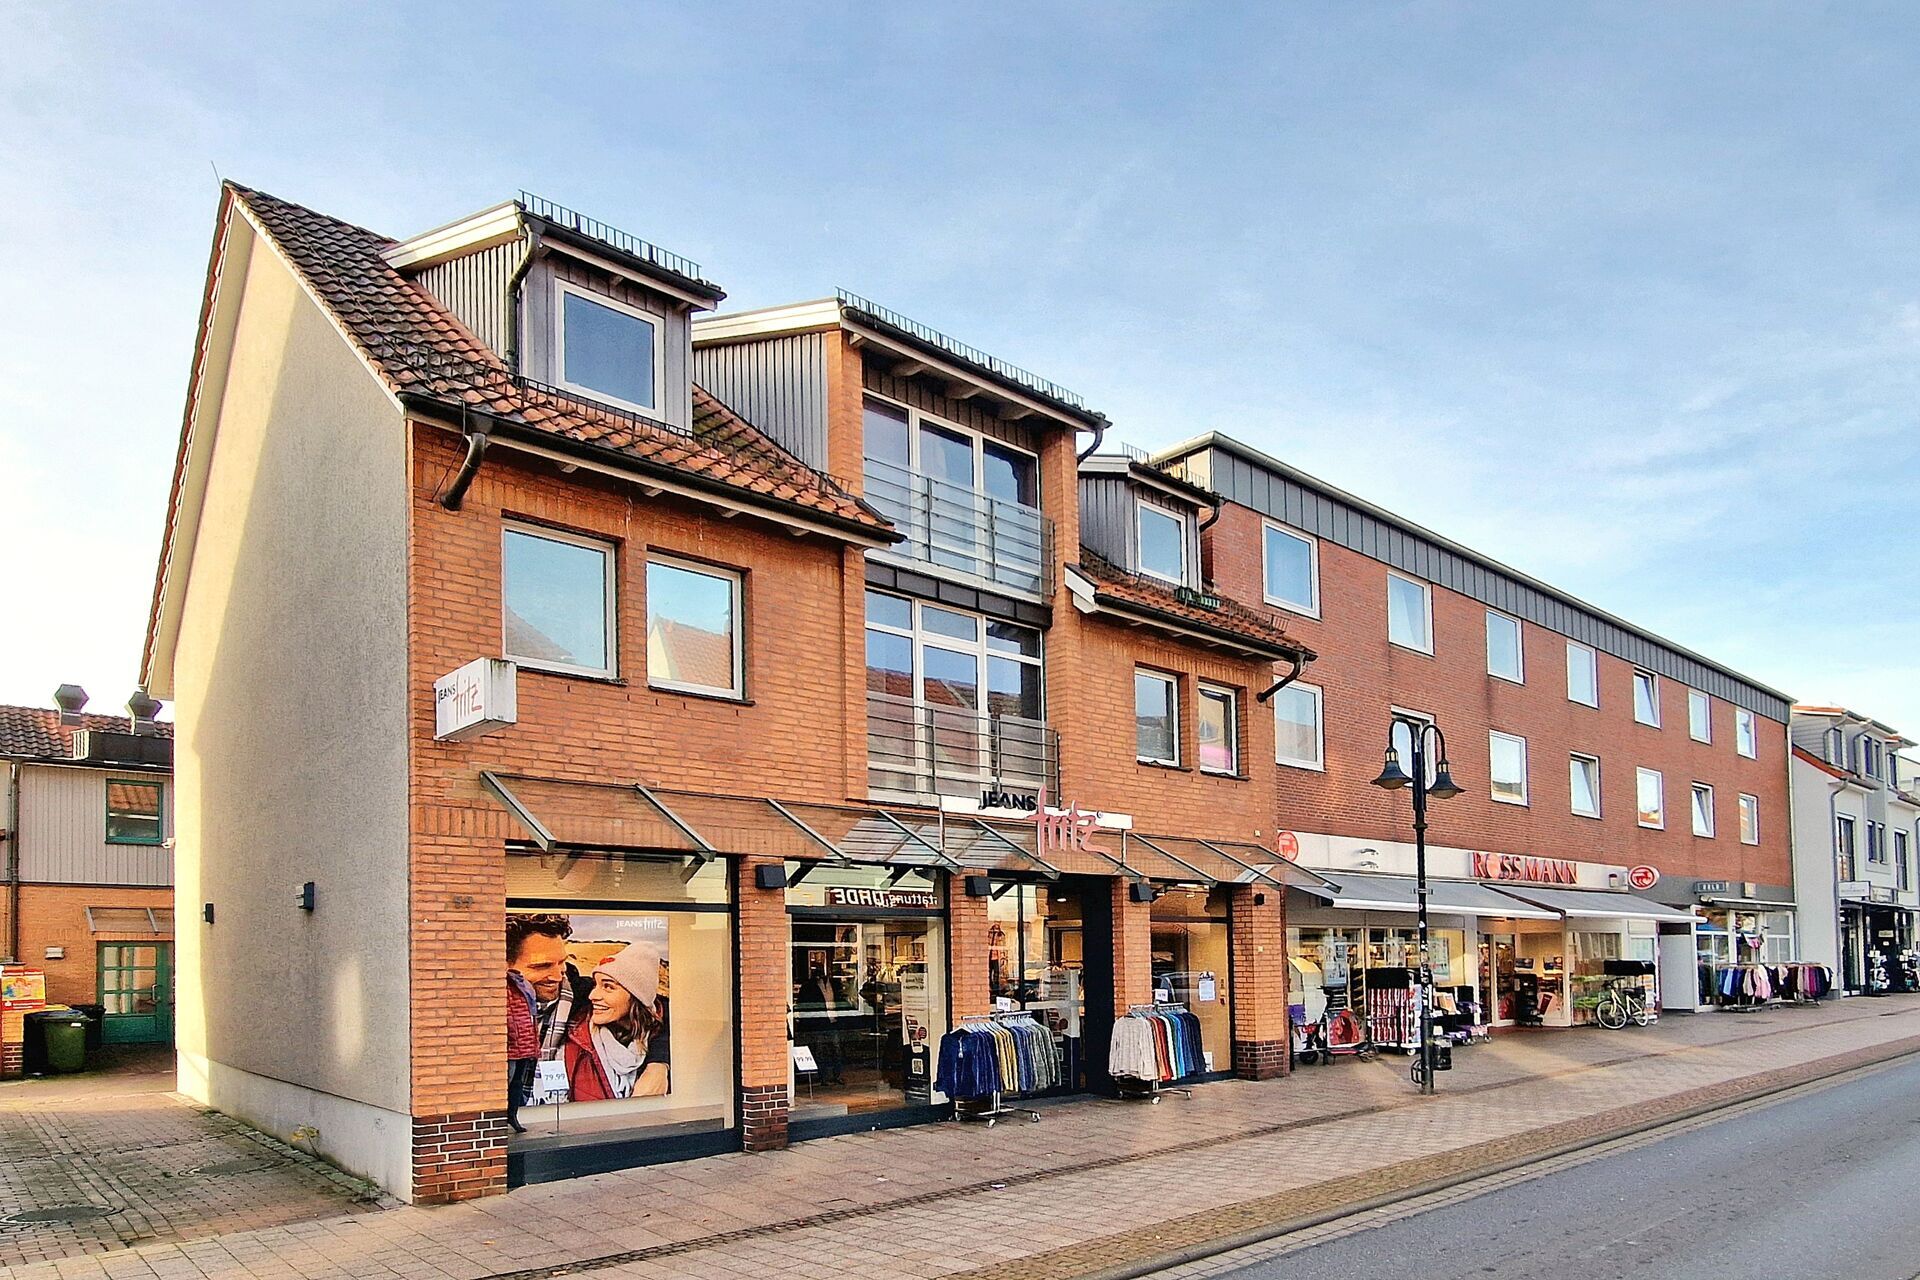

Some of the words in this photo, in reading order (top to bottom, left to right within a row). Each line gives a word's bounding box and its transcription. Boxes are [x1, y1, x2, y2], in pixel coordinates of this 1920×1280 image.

[438, 684, 456, 704] JEANS
[978, 790, 1037, 811] JEANS
[616, 919, 643, 928] JEANS
